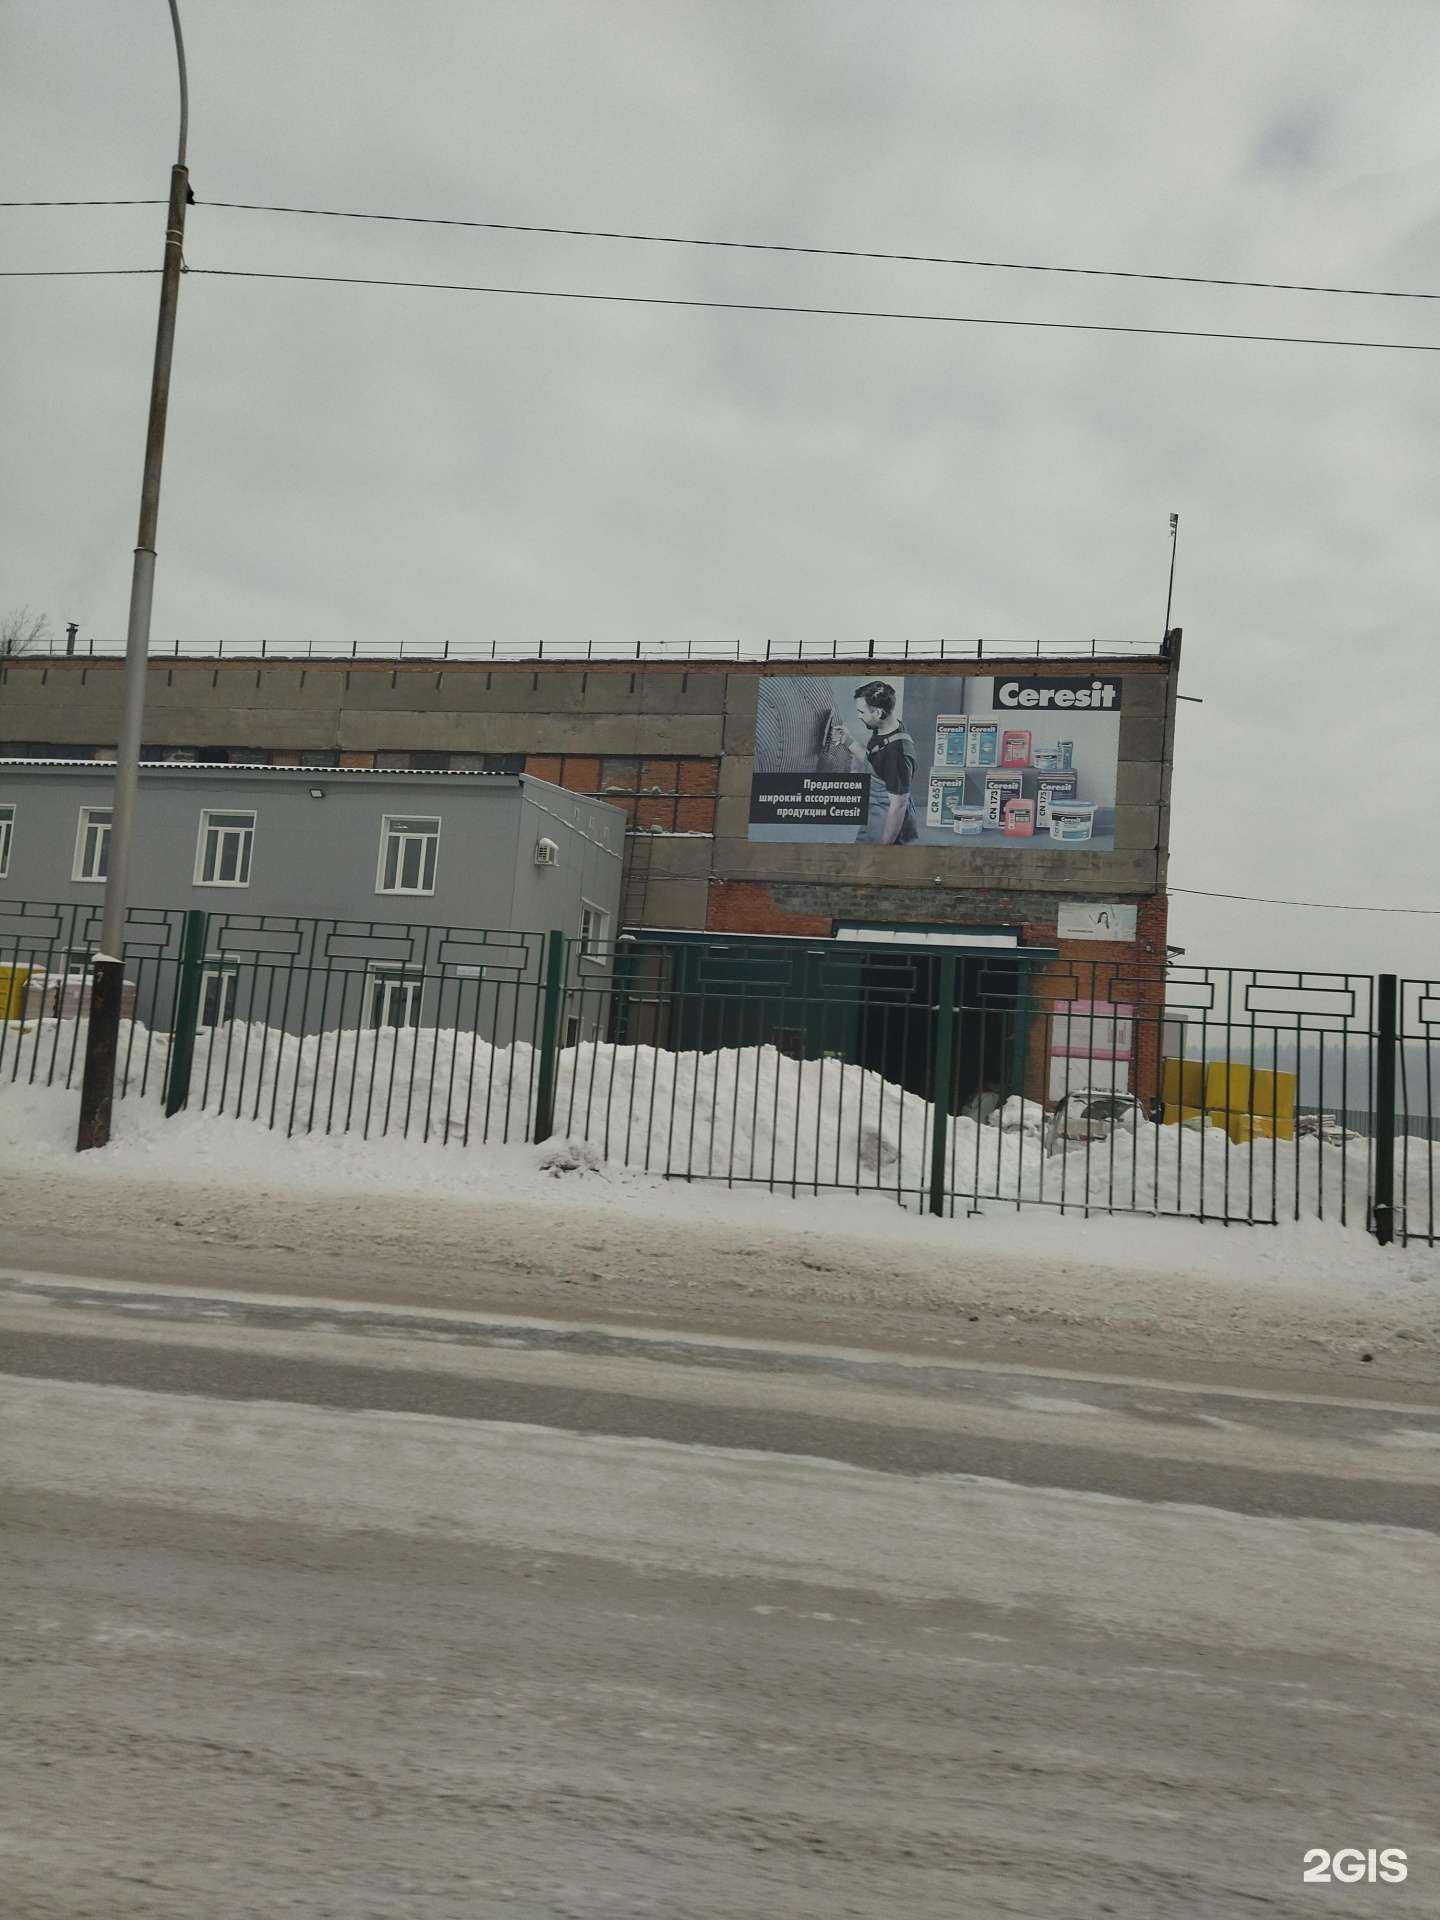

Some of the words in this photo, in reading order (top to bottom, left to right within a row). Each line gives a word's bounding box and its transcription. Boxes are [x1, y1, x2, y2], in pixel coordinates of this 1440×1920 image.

[998, 681, 1116, 708] Ceresit
[803, 779, 863, 791] Предлагаем
[988, 782, 1019, 790] Ceresit
[1041, 783, 1072, 791] Ceresit
[759, 793, 802, 805] широкий
[804, 794, 862, 805] ассортимент
[990, 790, 998, 804] 173
[1039, 791, 1047, 805] 175
[776, 806, 827, 818] продукции
[829, 806, 860, 817] Ceresit
[931, 801, 940, 813] CR
[1039, 805, 1046, 816] CN
[989, 807, 997, 820] CN
